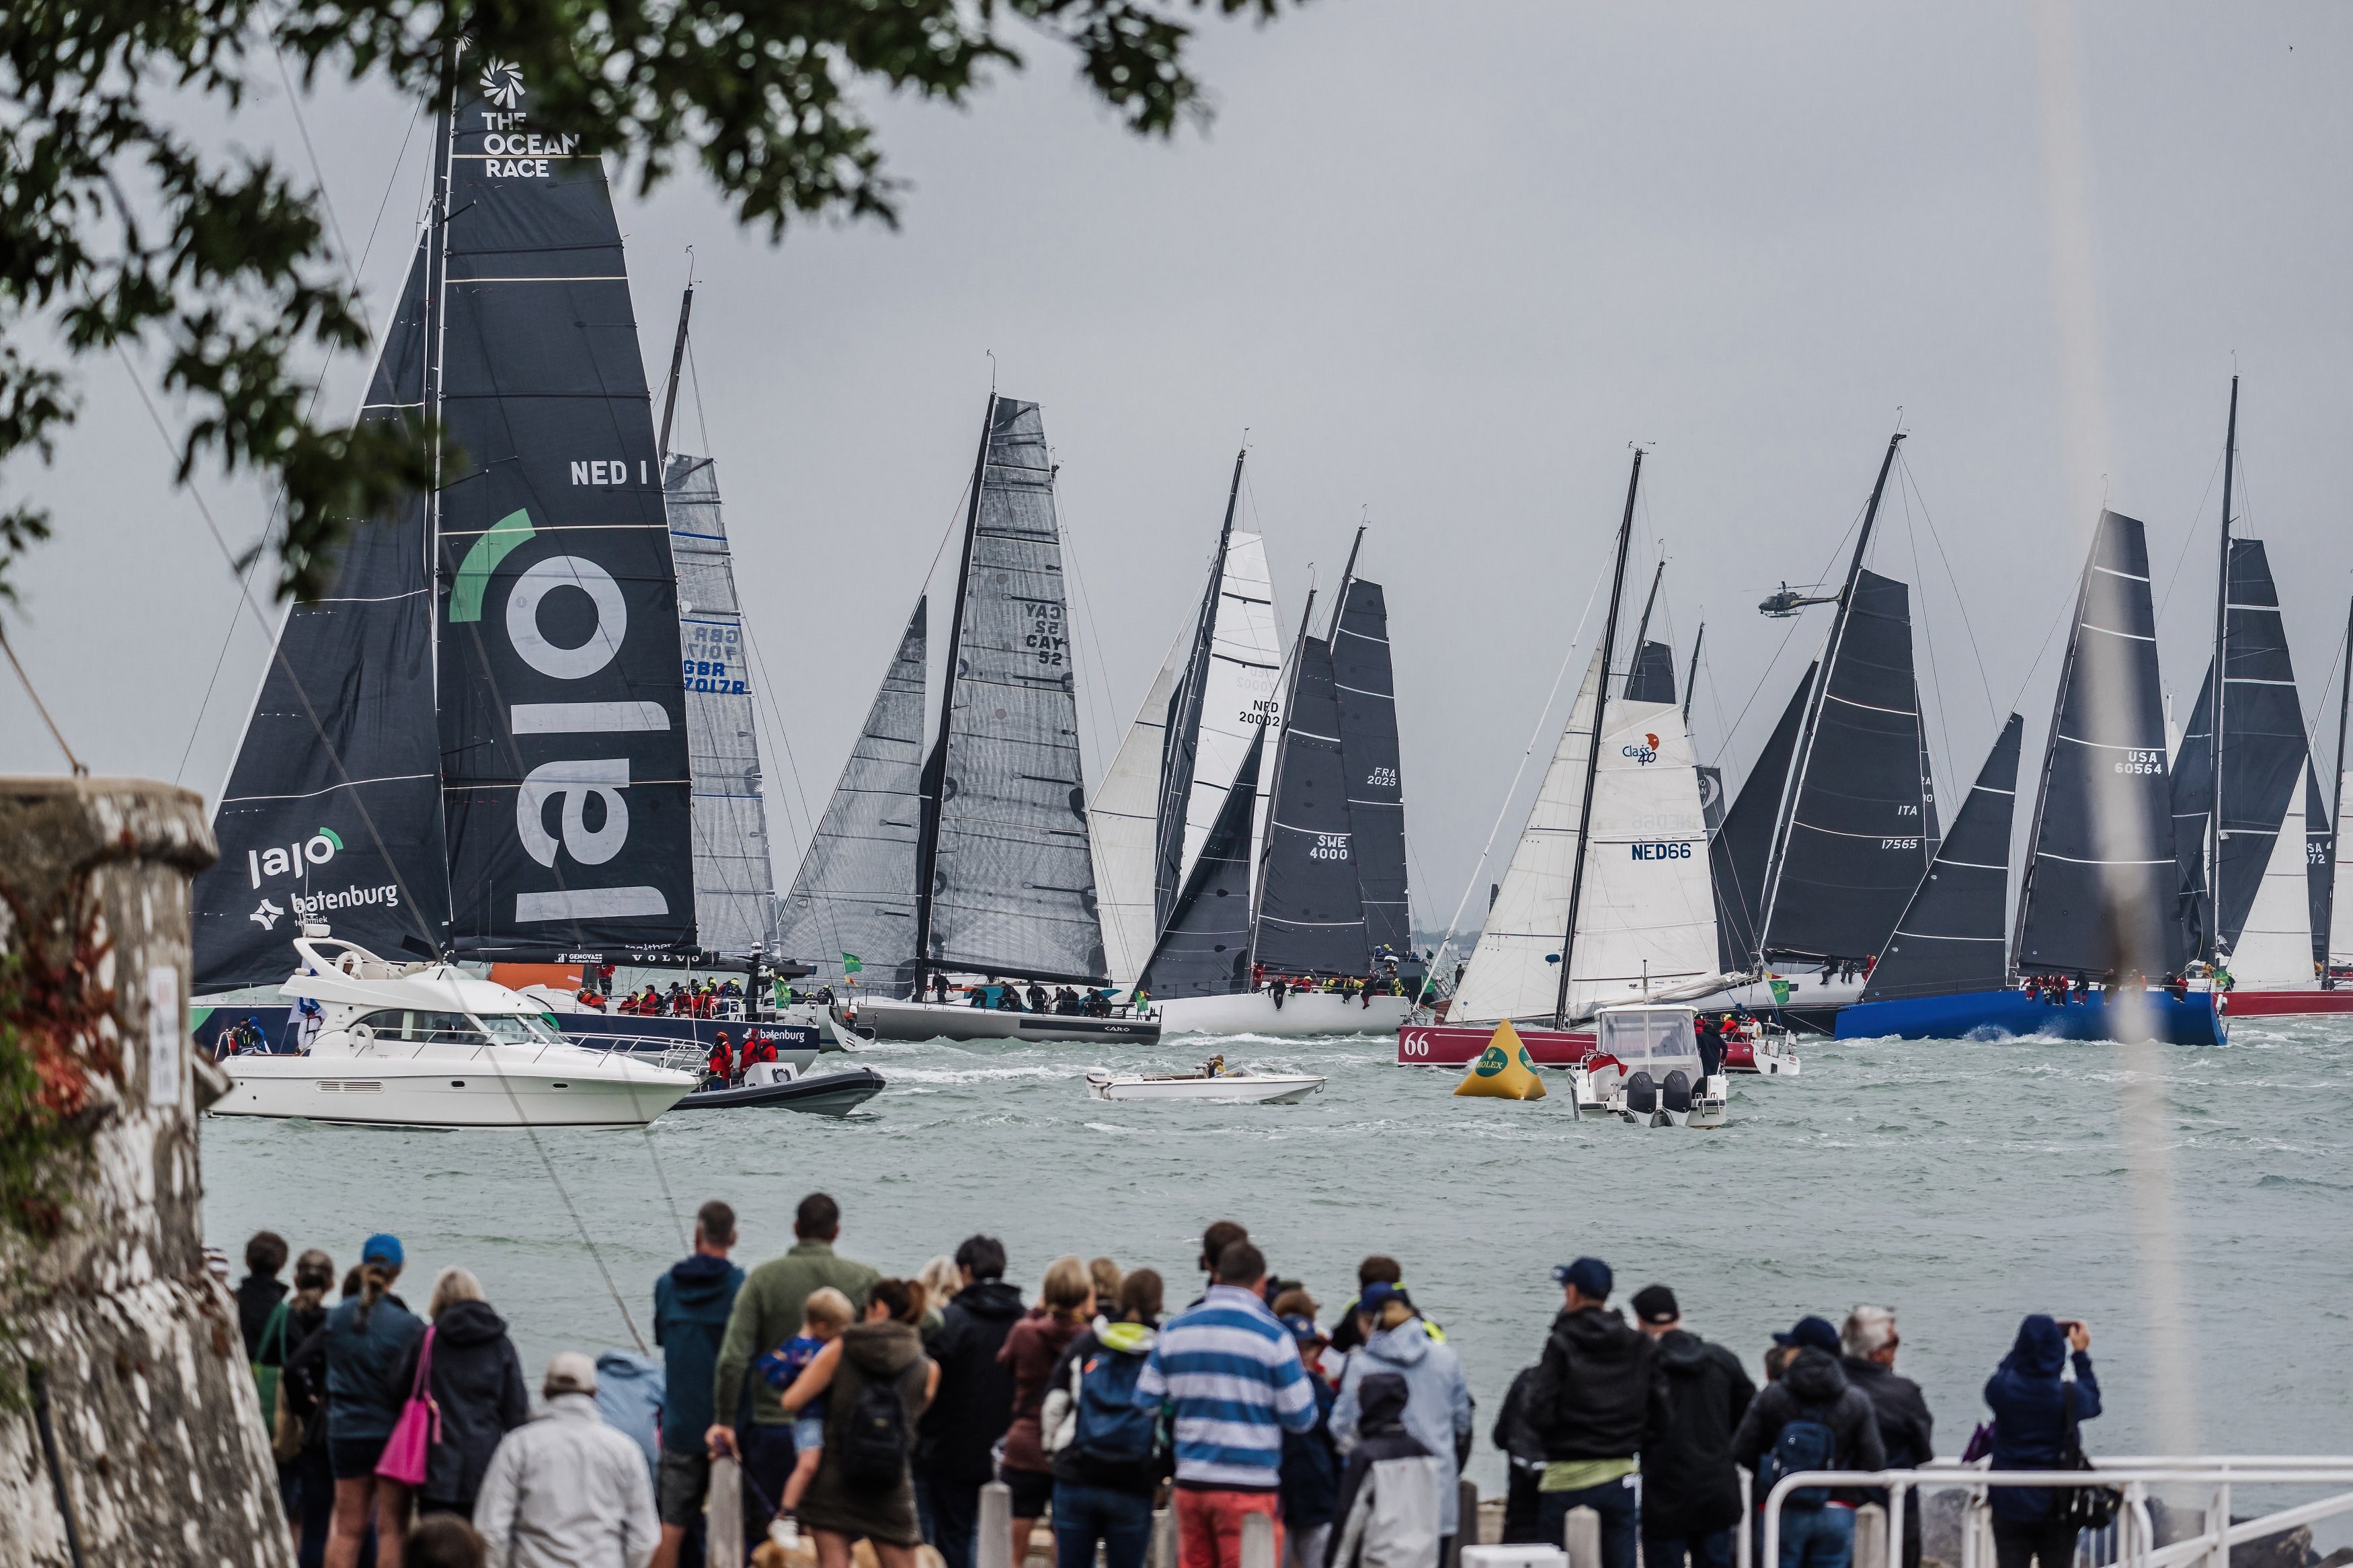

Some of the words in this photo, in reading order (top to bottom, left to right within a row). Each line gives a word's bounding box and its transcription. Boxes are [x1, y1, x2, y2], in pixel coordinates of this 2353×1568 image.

[481, 112, 526, 130] THE
[484, 133, 580, 155] OCEAN
[486, 159, 549, 177] RACE
[571, 460, 627, 485] NED
[1026, 634, 1064, 651] CAY
[1039, 651, 1062, 666] 52
[684, 660, 725, 677] GBR
[685, 677, 745, 695] 7017R
[1253, 700, 1279, 712] NED
[1622, 745, 1650, 757] Class
[2128, 751, 2157, 763] USA
[1637, 751, 1657, 766] 40
[1374, 767, 1396, 778] FRA
[2114, 764, 2162, 775] 60564
[1367, 776, 1396, 786] 2025
[1898, 805, 1917, 816] ITA
[1317, 835, 1347, 848] SWE
[1882, 839, 1918, 850] 17565
[1310, 846, 1349, 860] 4000
[1632, 843, 1691, 860] NED66
[2307, 854, 2325, 864] 72
[290, 884, 399, 914] batenburg
[1404, 1031, 1429, 1056] 66
[1476, 1061, 1503, 1069] ROLEX
